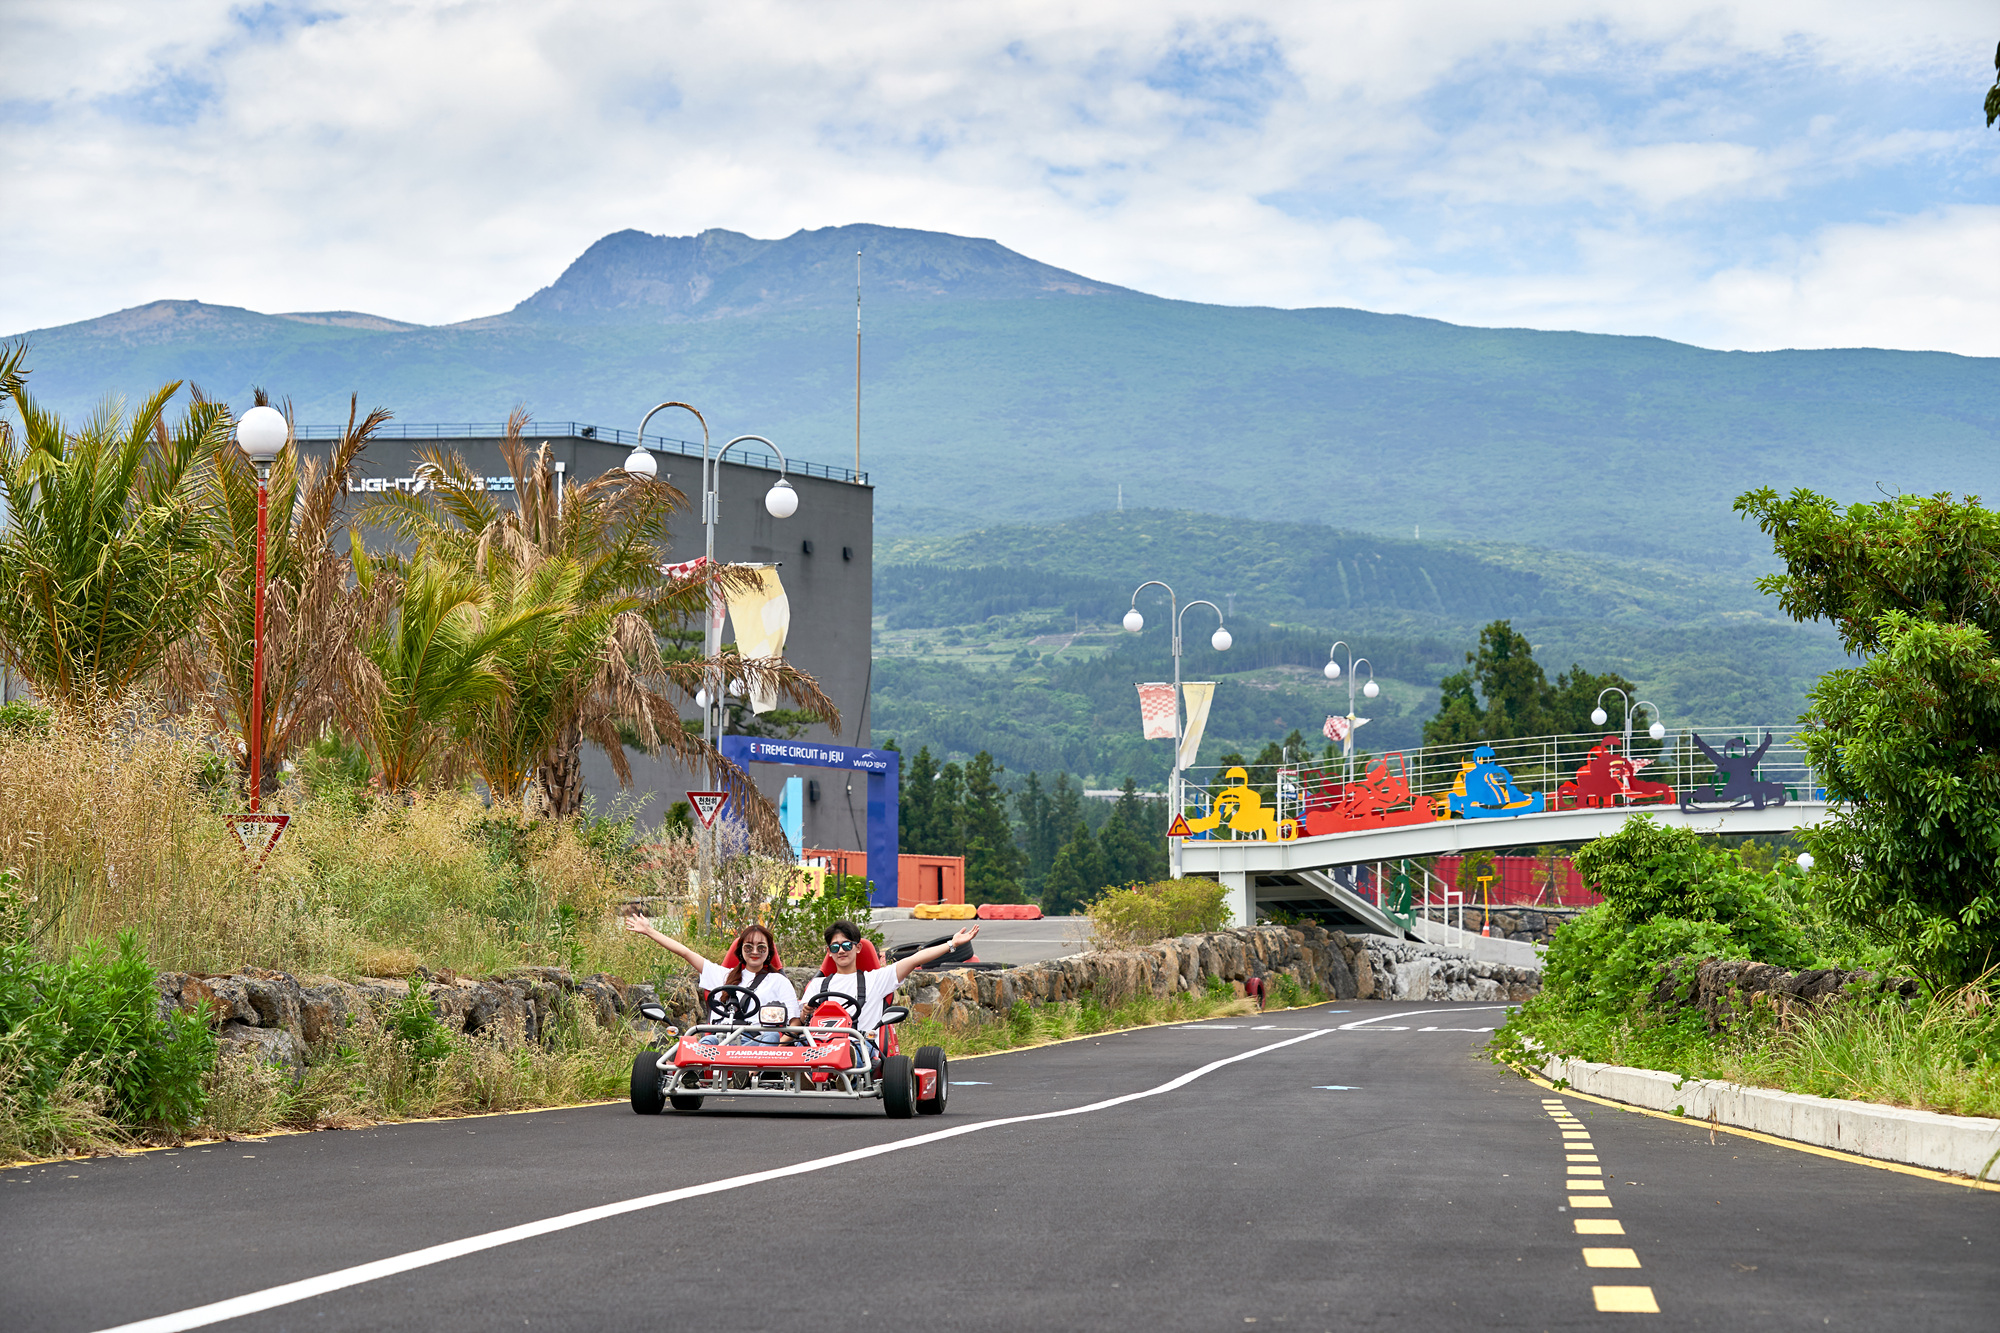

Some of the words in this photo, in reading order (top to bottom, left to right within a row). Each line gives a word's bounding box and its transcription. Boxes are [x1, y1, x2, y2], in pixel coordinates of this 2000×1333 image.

[750, 743, 787, 756] EXTREME
[788, 747, 818, 759] CIRCUIT
[820, 750, 827, 760] in
[828, 751, 844, 763] JEJU
[698, 796, 717, 805] 천천히
